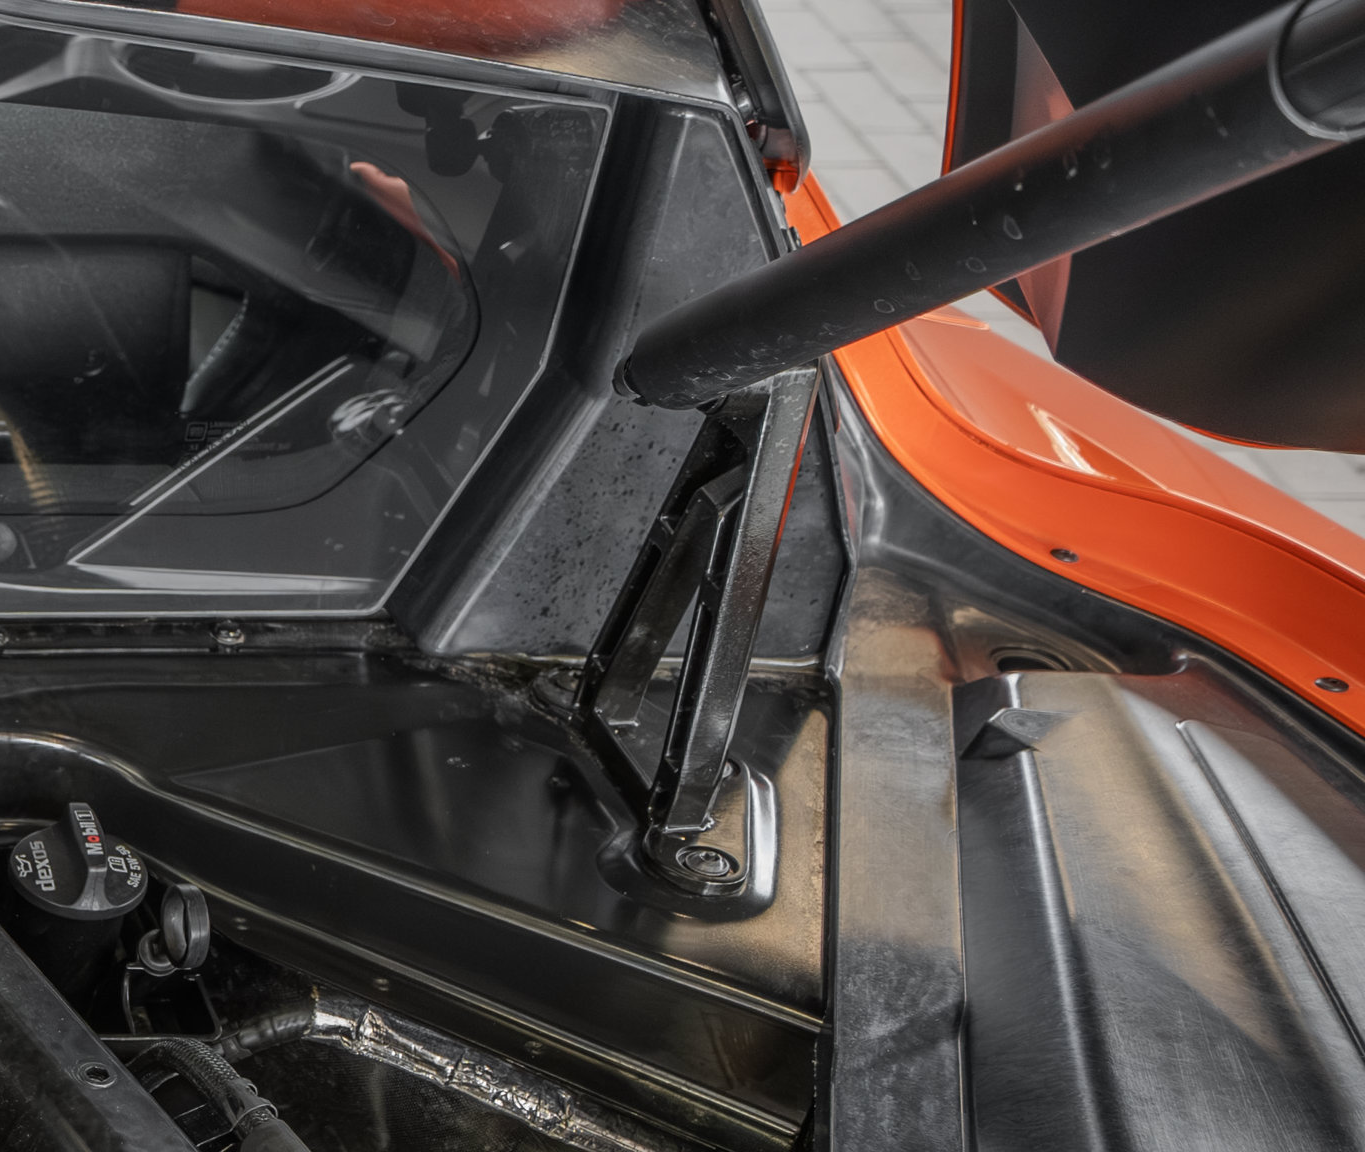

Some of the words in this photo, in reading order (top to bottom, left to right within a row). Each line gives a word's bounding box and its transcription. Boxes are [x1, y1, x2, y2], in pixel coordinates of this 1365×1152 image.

[79, 822, 105, 855] Mobil
[29, 840, 56, 892] dexos
[127, 872, 142, 888] SAE
